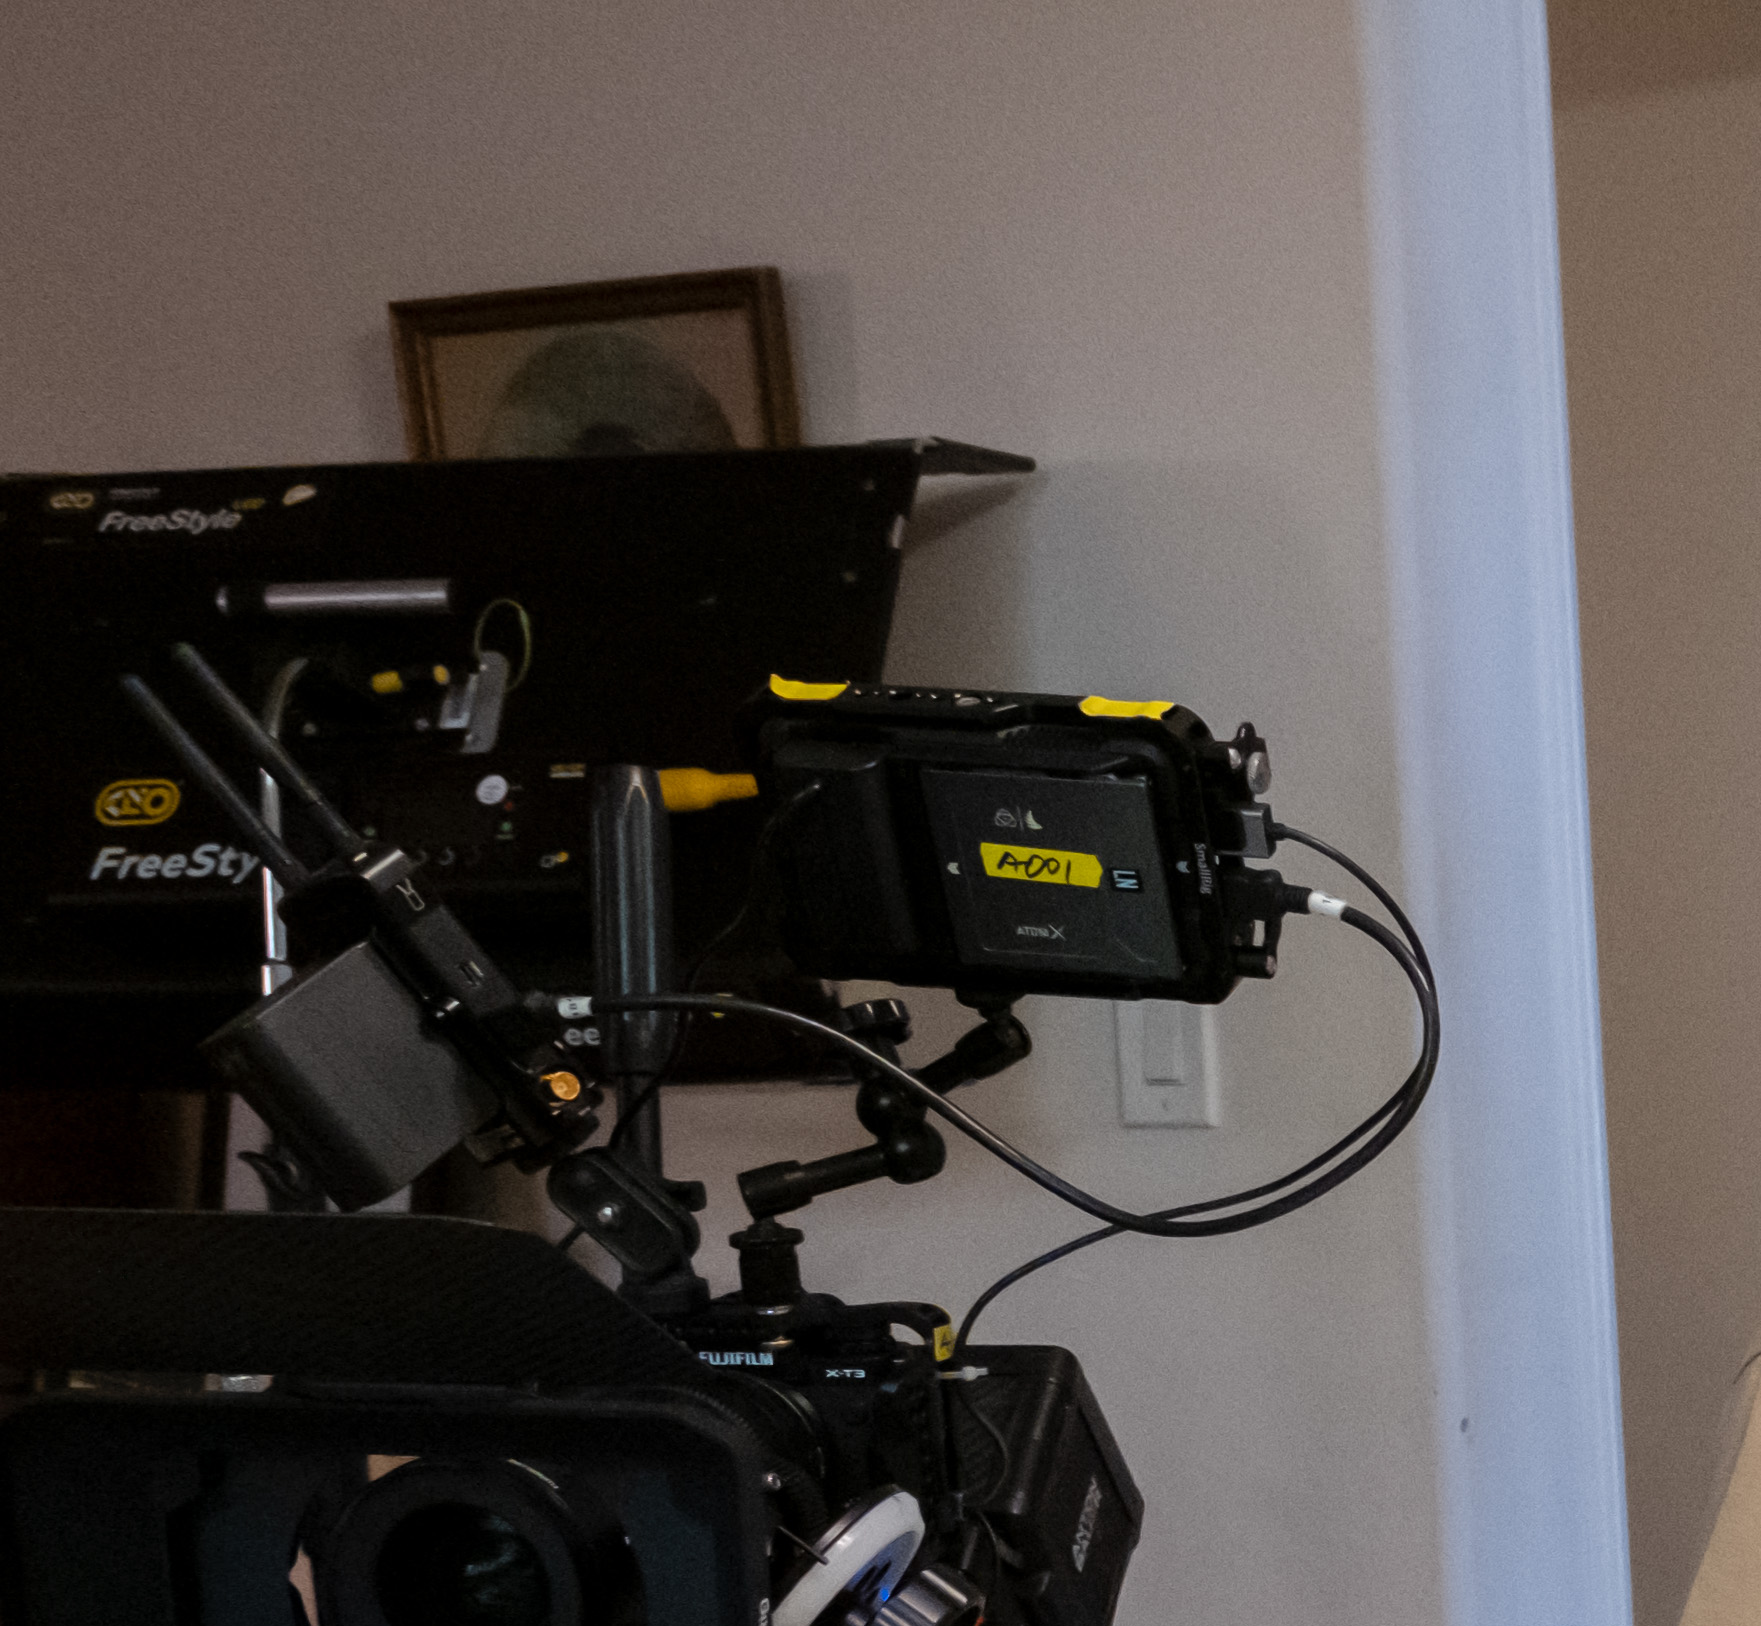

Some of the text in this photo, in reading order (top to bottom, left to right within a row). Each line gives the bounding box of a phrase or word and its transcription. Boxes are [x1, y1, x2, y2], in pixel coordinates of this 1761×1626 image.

[90, 842, 262, 884] FreeSty
[997, 851, 1072, 885] A001
[825, 1368, 866, 1379] X-T3
